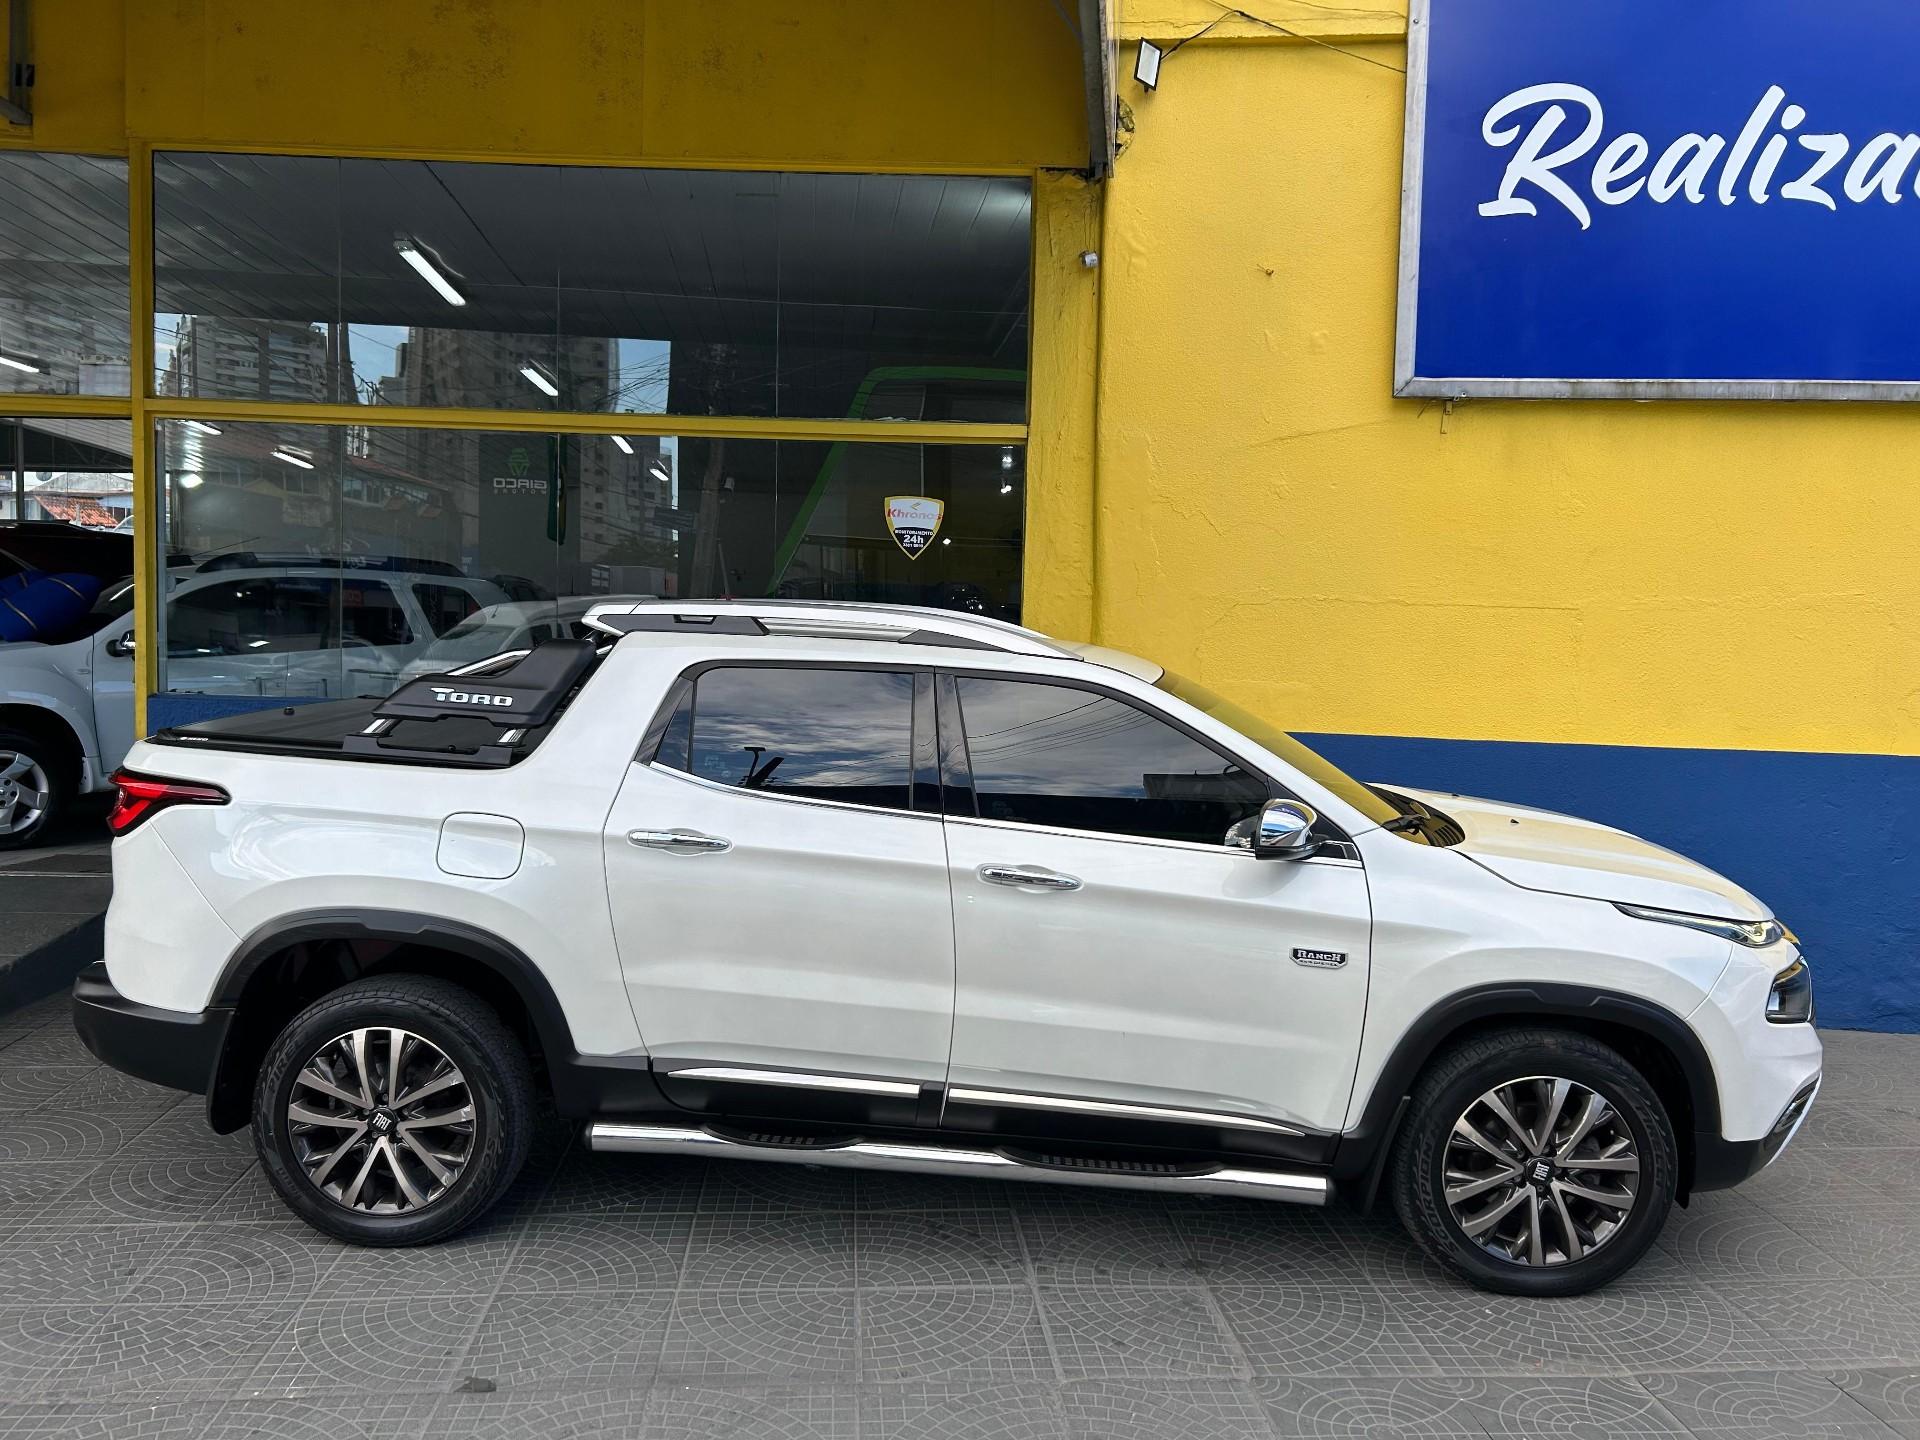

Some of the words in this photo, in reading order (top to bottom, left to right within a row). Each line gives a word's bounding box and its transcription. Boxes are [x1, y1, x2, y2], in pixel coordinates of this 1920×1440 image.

[1478, 82, 1920, 231] Realiza
[886, 508, 944, 521] Khronos
[903, 534, 924, 544] 24h
[430, 687, 514, 707] TORO
[1296, 950, 1342, 962] RANCH
[372, 1112, 393, 1130] FIAT
[1532, 1161, 1550, 1180] FIAT
